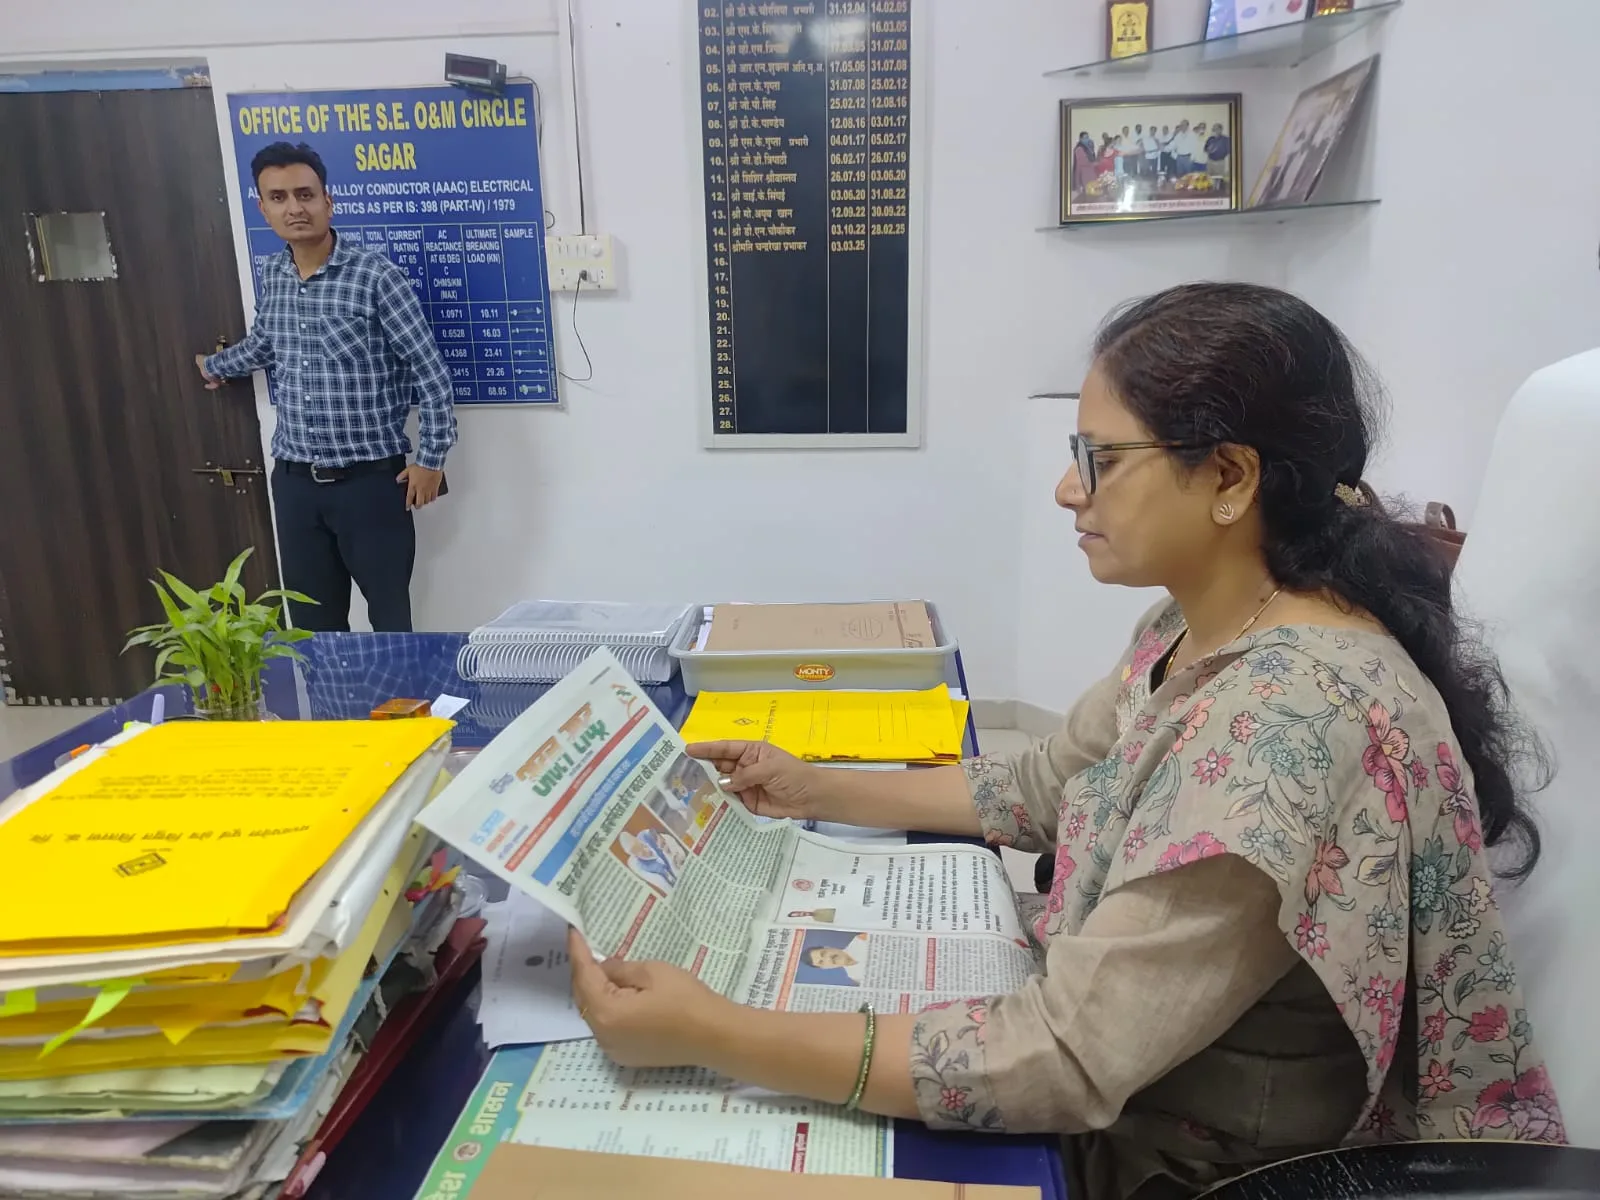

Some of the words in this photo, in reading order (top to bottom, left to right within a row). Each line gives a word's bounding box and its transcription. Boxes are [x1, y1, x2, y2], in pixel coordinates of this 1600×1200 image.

[704, 8, 719, 18] 02.
[705, 26, 720, 36] 03.
[706, 45, 720, 55] 04.
[706, 64, 720, 74] 05.
[707, 82, 721, 92] 06.
[872, 78, 907, 90] 25.02.12
[708, 102, 722, 113] 07.
[830, 98, 866, 109] 25.02.12
[239, 106, 302, 135] OFFICE
[306, 104, 330, 133] OF
[334, 103, 371, 131] THE
[375, 101, 410, 130] S.E.
[414, 100, 456, 130] O&M
[461, 98, 527, 128] CIRCLE
[708, 120, 722, 128] 08.
[871, 116, 906, 127] 03.01.17
[709, 138, 724, 148] 09.
[830, 134, 866, 146] 04.01.17
[871, 133, 906, 144] 05.02.17
[355, 142, 416, 171] SAGAR
[710, 157, 724, 166] 10.
[830, 153, 866, 164] 06.02.17
[871, 152, 906, 163] 26.07.19
[711, 175, 724, 184] 11.
[831, 171, 866, 182] 26.07.19
[332, 184, 364, 196] ALLOY
[366, 182, 430, 195] CONDUCTOR
[432, 181, 468, 195] (AAAC)
[470, 180, 533, 193] ELECTRICAL
[712, 193, 725, 201] 12.
[368, 202, 381, 213] AS
[384, 202, 403, 213] PER
[406, 201, 418, 213] IS:
[420, 200, 438, 212] 398
[440, 200, 485, 214] (PART-IV)
[493, 199, 516, 212] 1979
[712, 211, 726, 219] 13.
[438, 230, 447, 239] AC
[466, 230, 496, 238] ULTIMATE
[504, 229, 534, 238] SAMPLE
[713, 228, 726, 236] 14.
[832, 224, 866, 235] 03.10.22
[871, 224, 905, 235] 28.02.25
[366, 232, 384, 241] TOTAL
[388, 230, 421, 240] CURRENT
[394, 243, 420, 252] RATING
[426, 242, 462, 251] REACTANCE
[466, 242, 500, 250] BREAKING
[714, 244, 727, 252] 15.
[832, 240, 865, 252] 03.03.25
[430, 255, 438, 263] AT
[467, 254, 486, 263] LOAD
[487, 253, 500, 264] (KN)
[714, 258, 728, 266] 16.
[715, 286, 728, 294] 18.
[441, 291, 458, 300] (MAX)
[716, 300, 729, 308] 19.
[716, 326, 730, 334] 21.
[716, 340, 731, 348] 22.
[484, 348, 502, 357] 23.41
[452, 368, 469, 376] .3415
[718, 366, 732, 374] 24.
[718, 394, 732, 402] 26.
[469, 1080, 514, 1135] शासन
